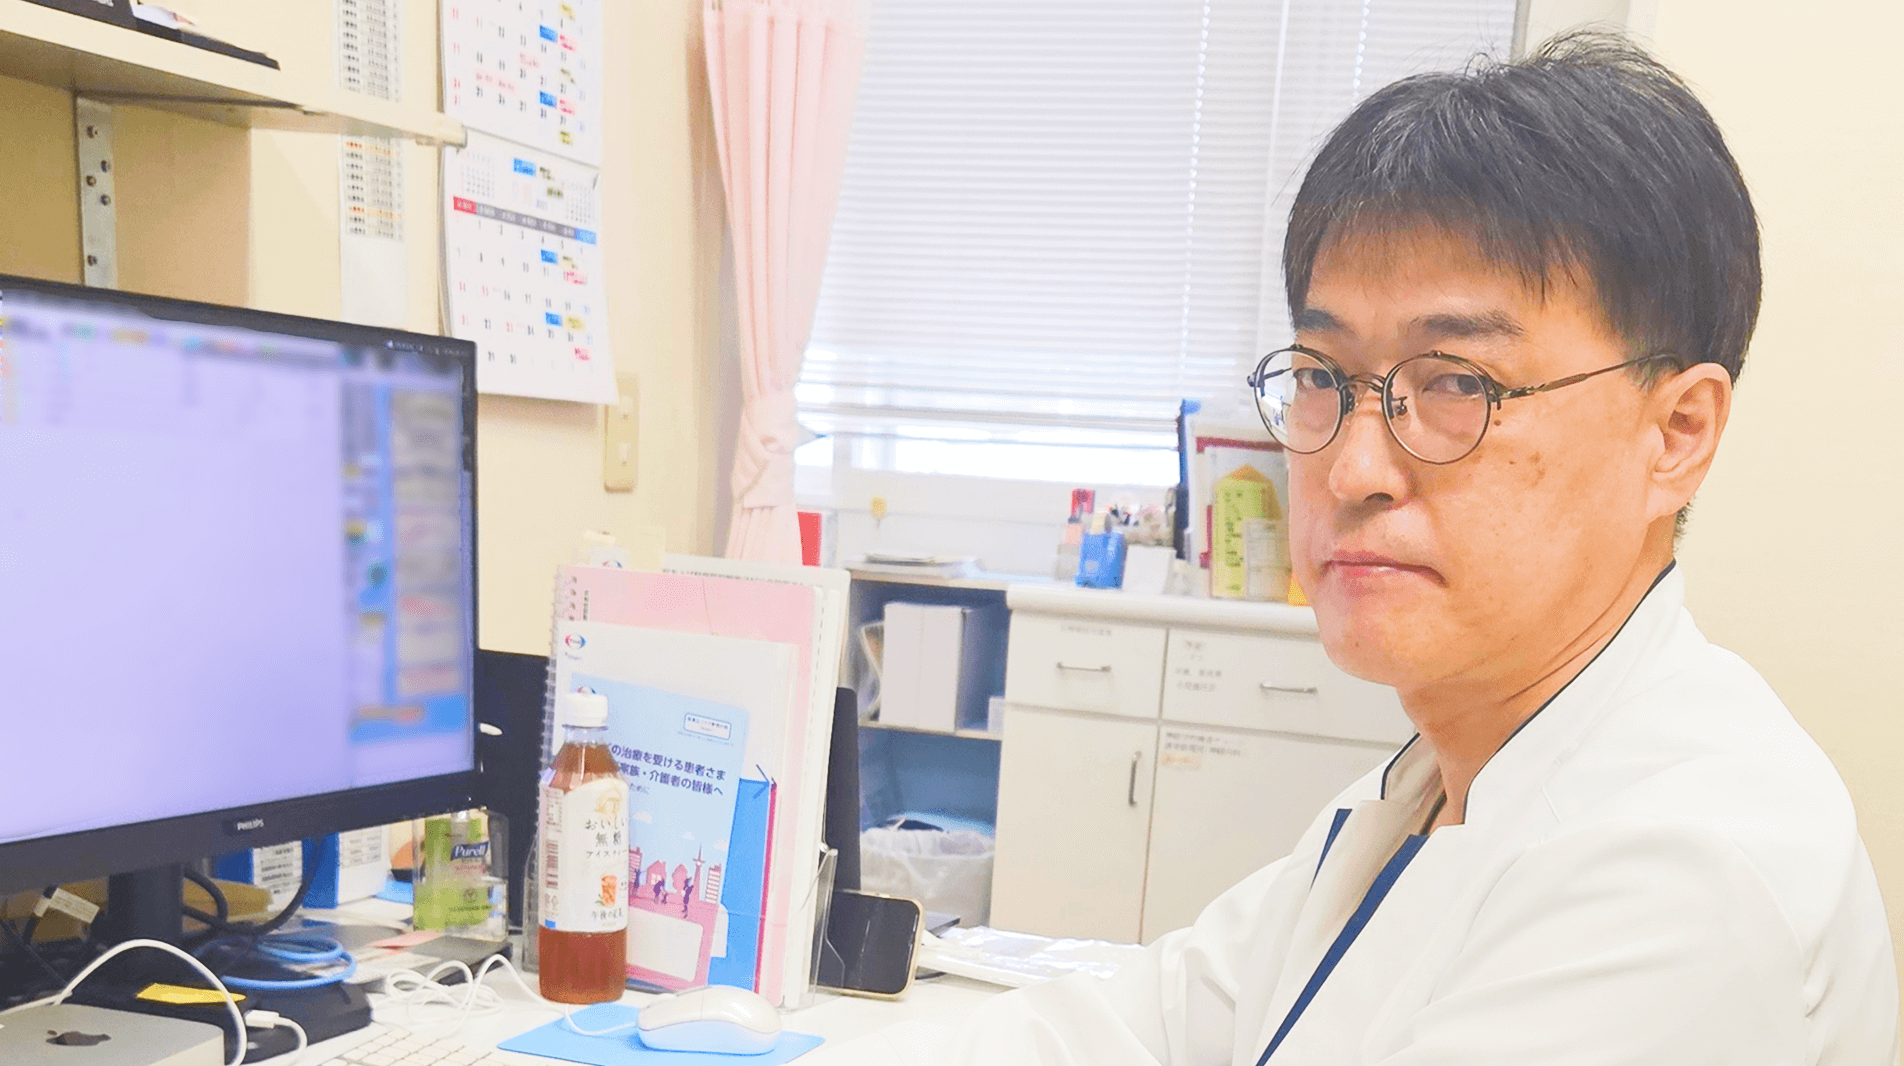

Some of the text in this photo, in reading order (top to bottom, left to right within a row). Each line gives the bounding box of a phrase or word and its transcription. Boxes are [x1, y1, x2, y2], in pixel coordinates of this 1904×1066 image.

[609, 743, 726, 781] の治療を受ける患者さま
[618, 761, 723, 796] 家族・介護者の皆様へ
[237, 818, 264, 831] PHILIPS
